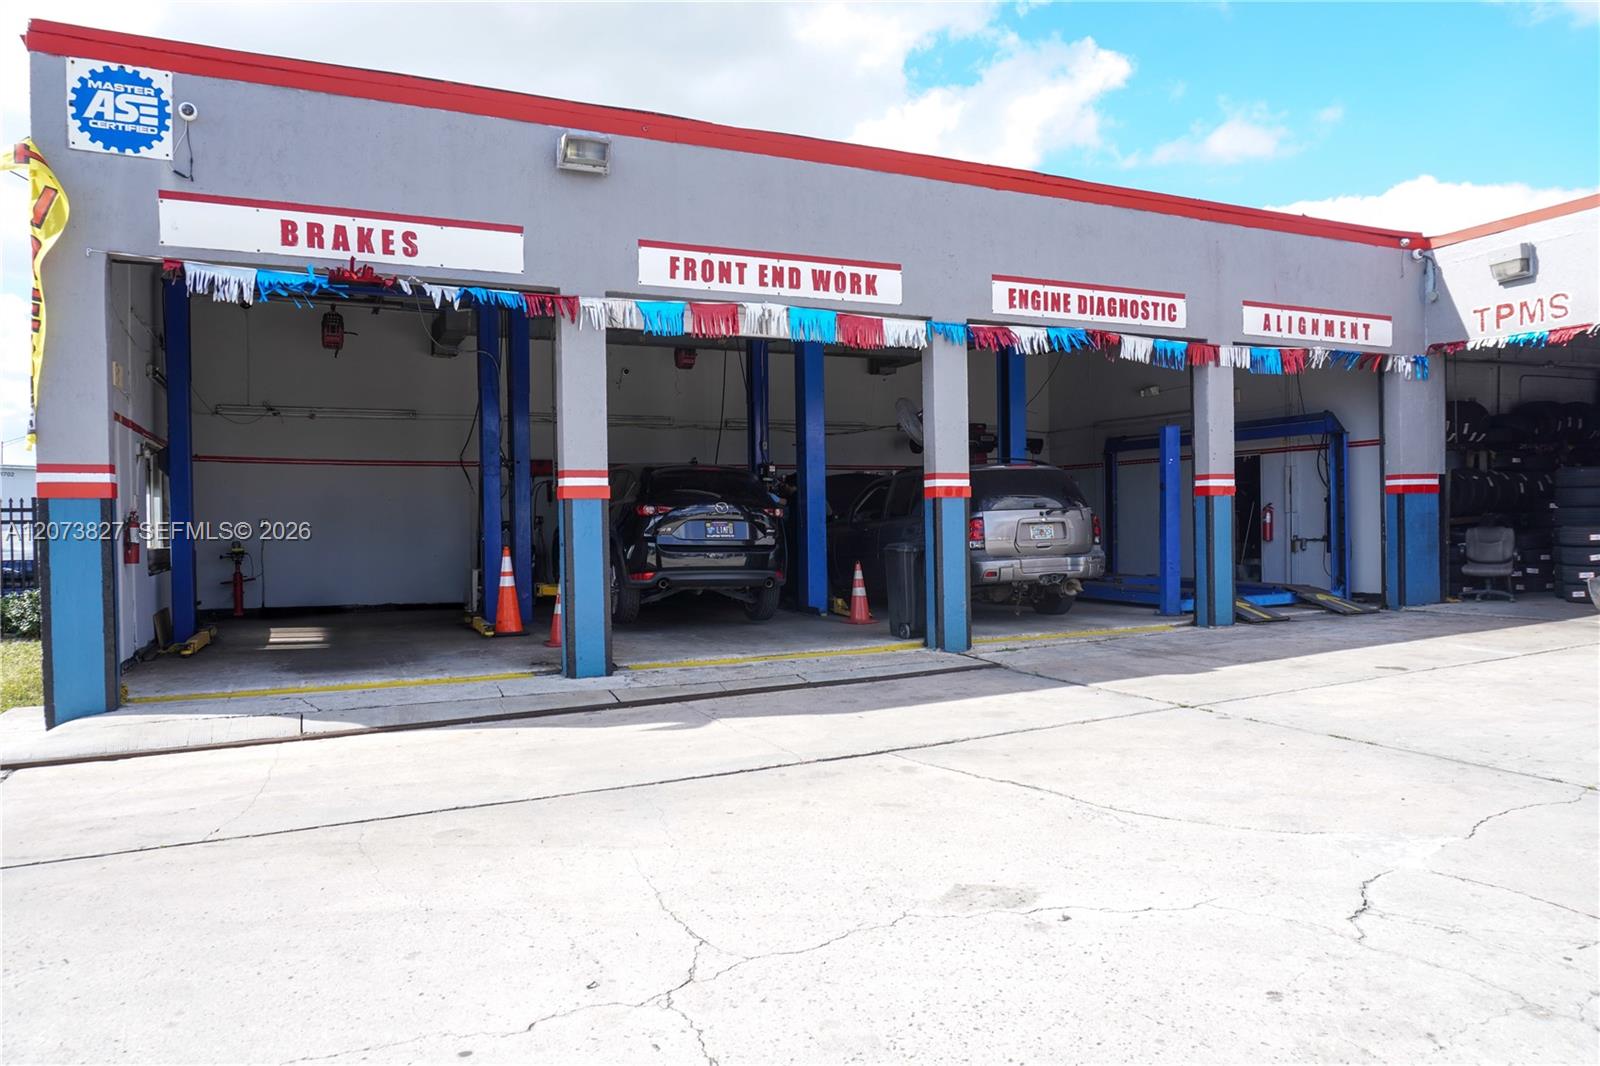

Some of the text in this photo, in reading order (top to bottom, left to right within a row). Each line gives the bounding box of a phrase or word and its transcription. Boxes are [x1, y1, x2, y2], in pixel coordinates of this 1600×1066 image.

[87, 79, 155, 97] MASTER
[82, 89, 159, 127] ASE
[88, 119, 159, 136] CERTIFIED
[280, 218, 419, 258] BRAKES
[669, 256, 879, 297] FRONT END WORK
[1008, 287, 1178, 323] ENGINE DIAGNOSTIC
[1473, 293, 1570, 332] TPMS
[1262, 312, 1372, 342] ALIGNMENT
